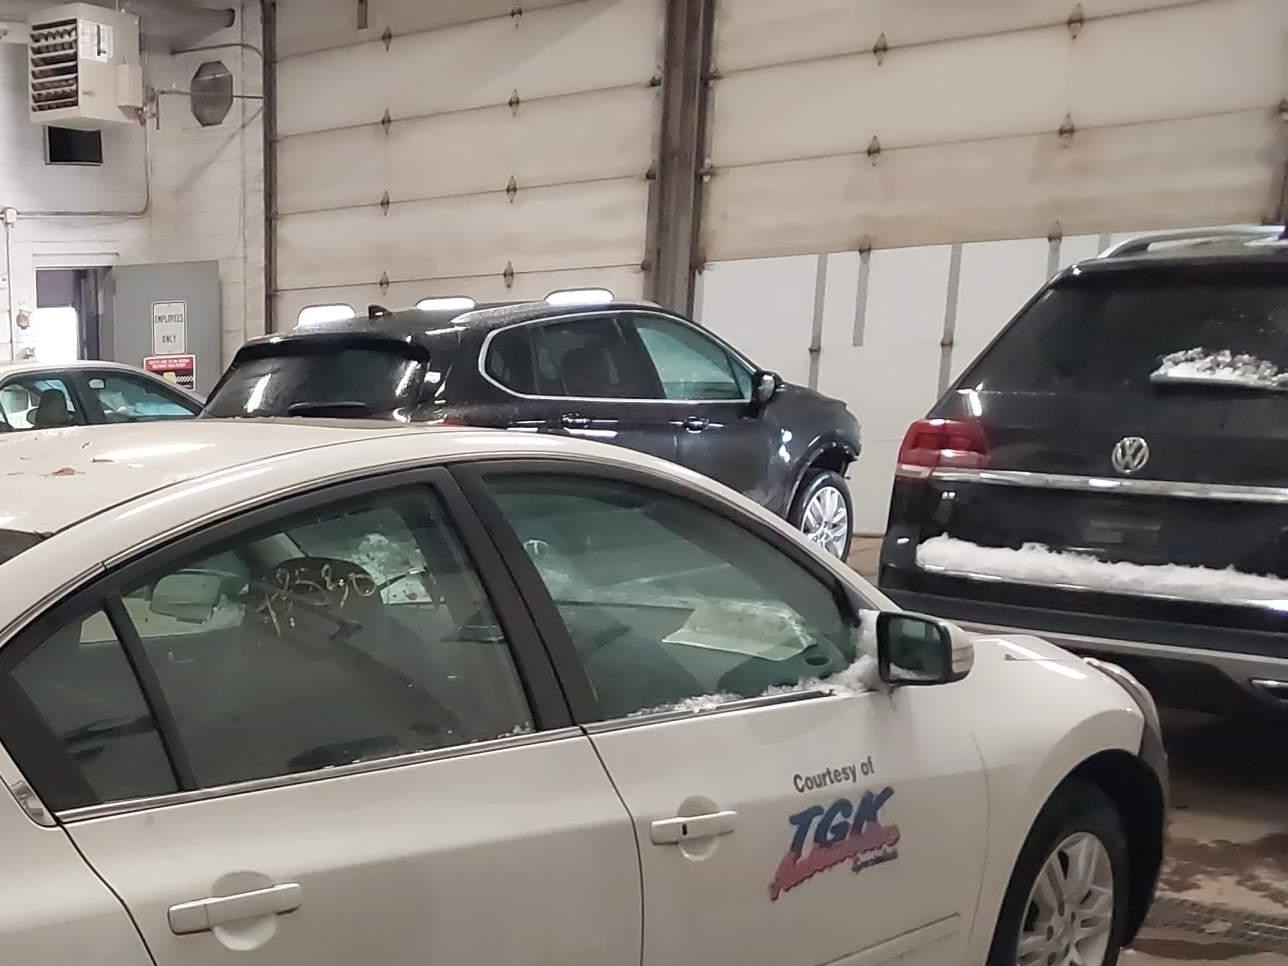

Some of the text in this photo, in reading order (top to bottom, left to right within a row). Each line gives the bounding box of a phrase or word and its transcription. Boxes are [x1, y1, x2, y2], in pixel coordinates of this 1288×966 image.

[162, 334, 176, 344] ONLY
[793, 755, 875, 793] Courtesy of
[788, 786, 895, 863] TGK
